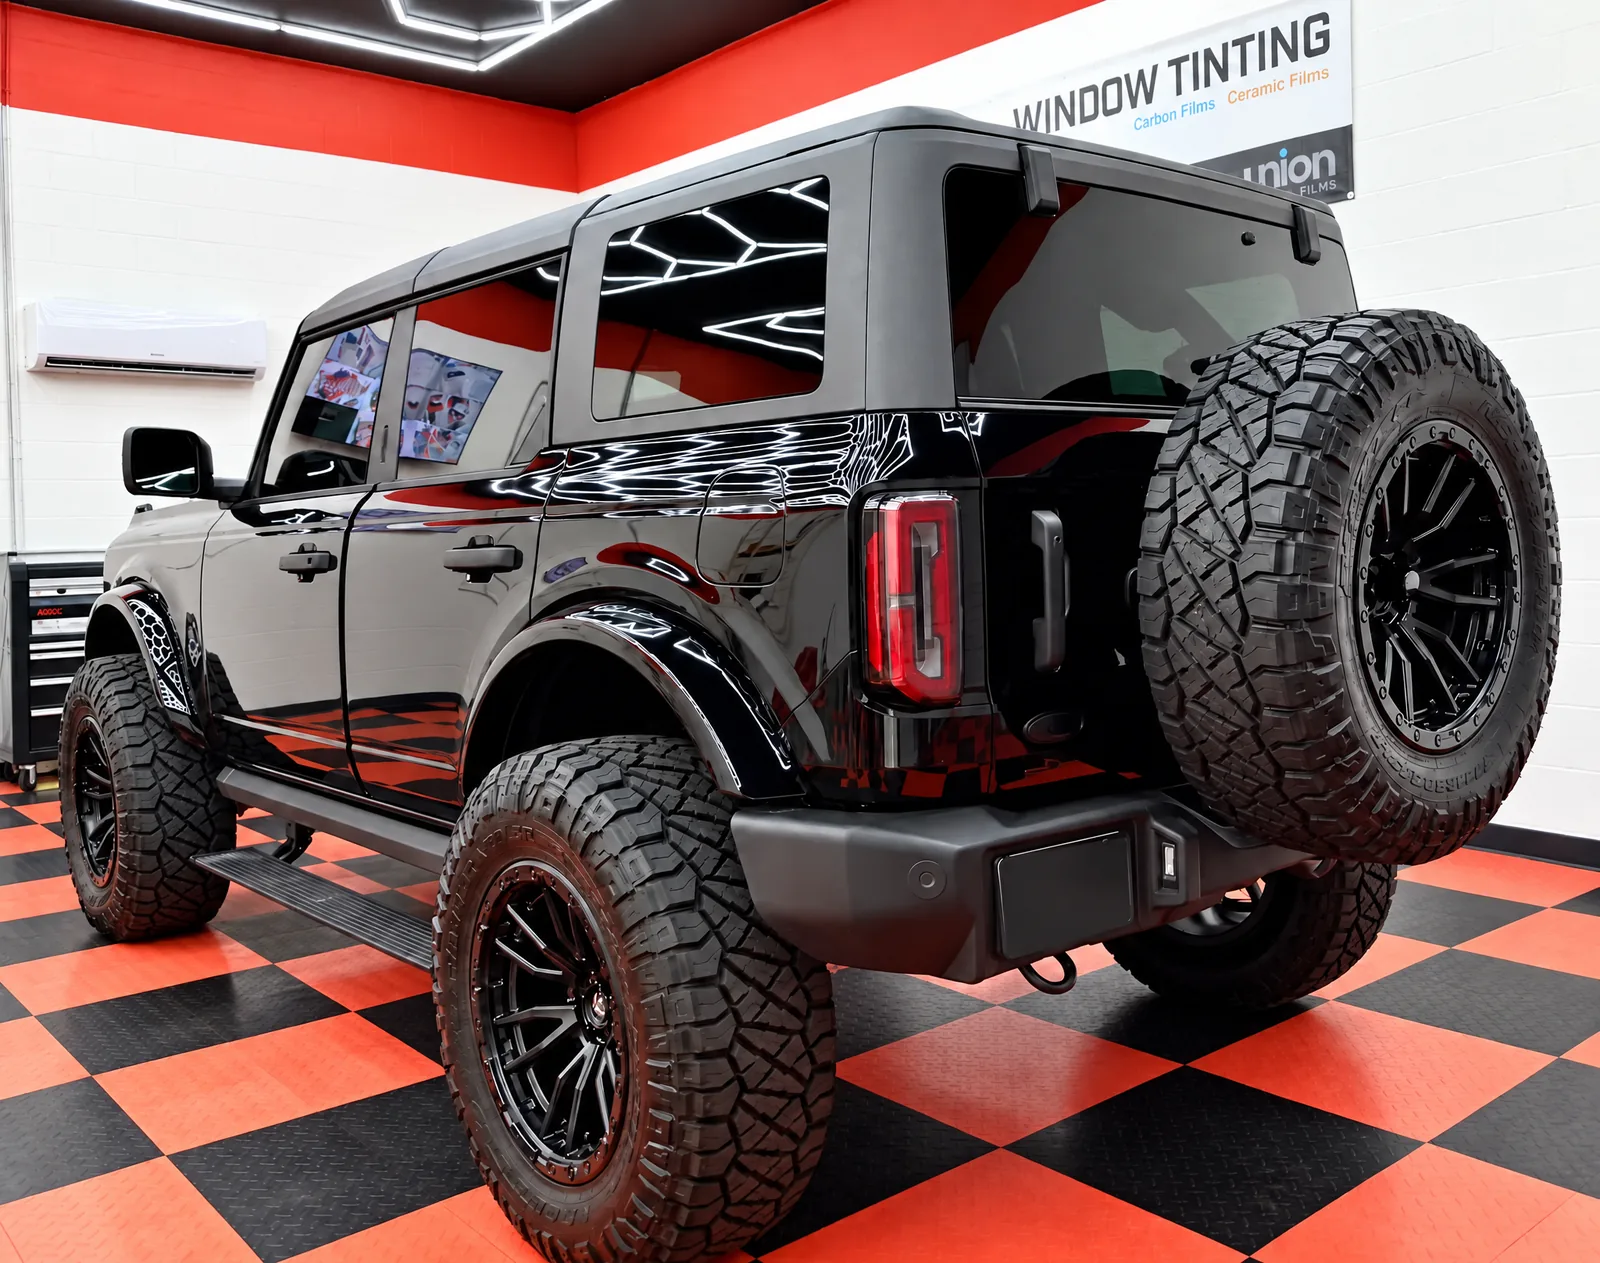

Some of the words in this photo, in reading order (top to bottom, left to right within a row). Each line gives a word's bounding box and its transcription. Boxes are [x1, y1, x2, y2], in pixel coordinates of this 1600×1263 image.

[1013, 63, 1159, 134] WINDOW
[1167, 11, 1330, 97] TINTING
[1227, 79, 1285, 105] Ceramic
[1289, 67, 1330, 88] Films
[1133, 110, 1177, 131] Carbon
[1181, 99, 1216, 118] Films
[1243, 147, 1337, 189] nion
[1300, 179, 1337, 197] FILMS
